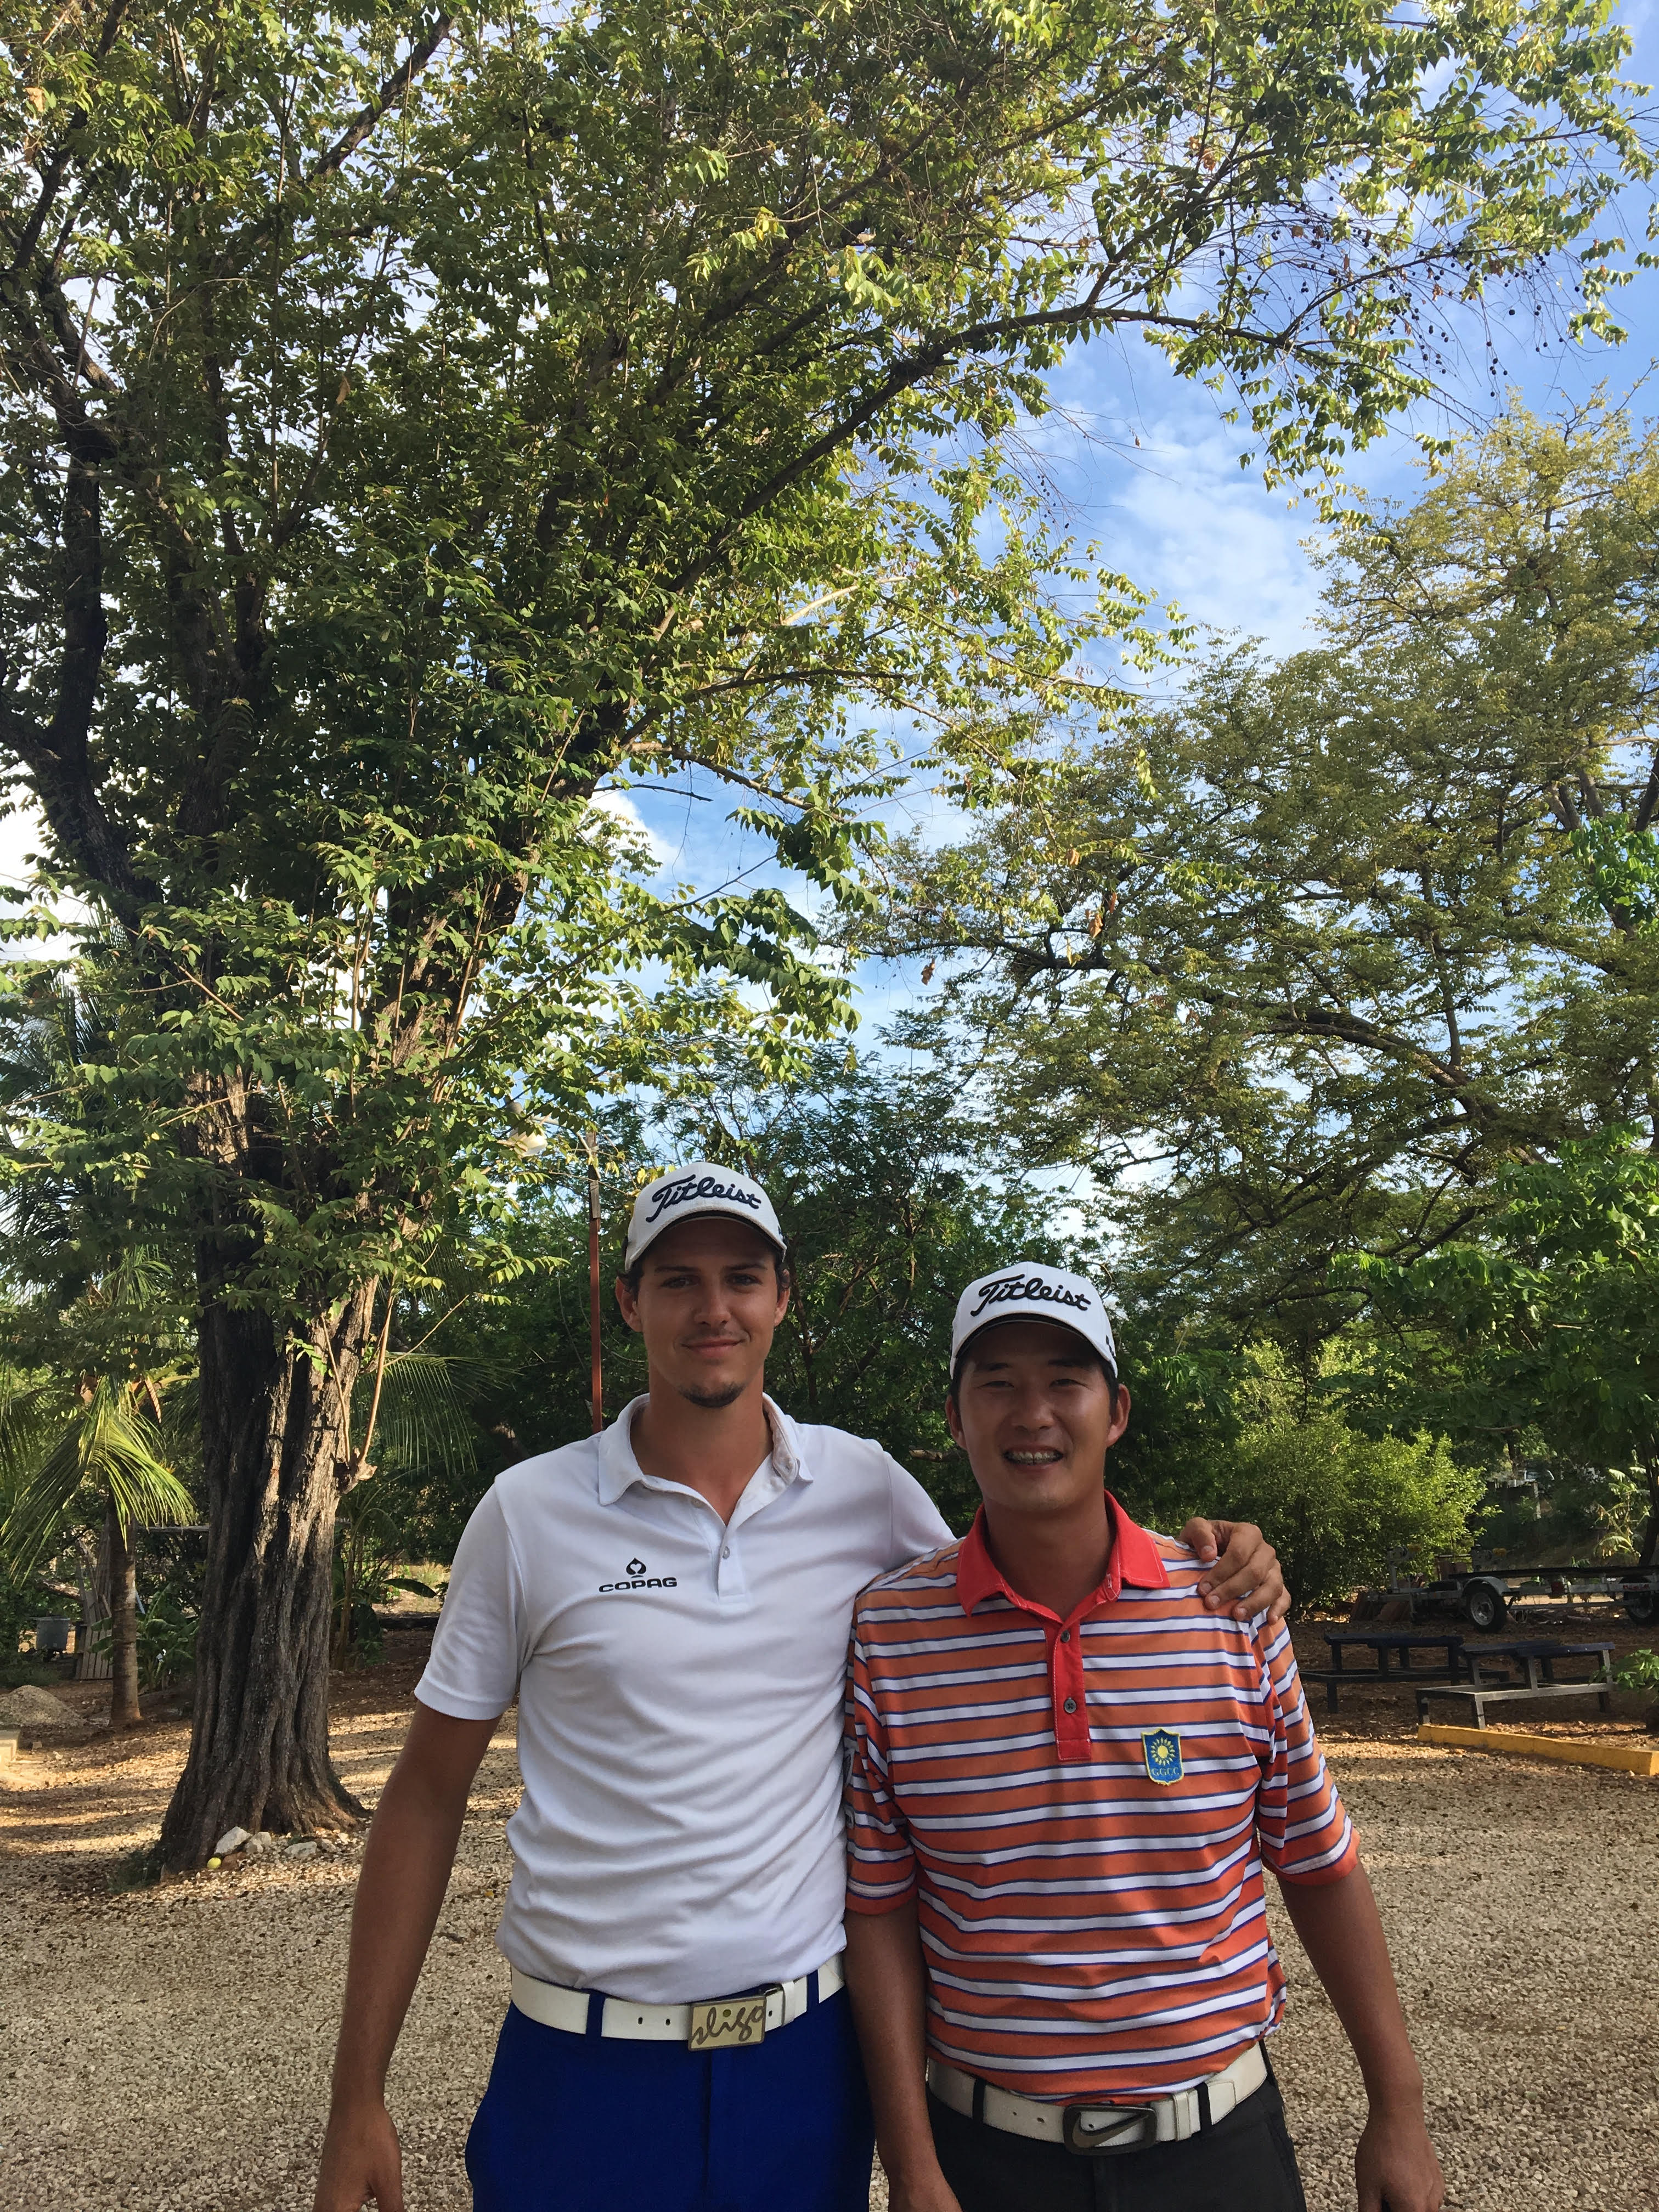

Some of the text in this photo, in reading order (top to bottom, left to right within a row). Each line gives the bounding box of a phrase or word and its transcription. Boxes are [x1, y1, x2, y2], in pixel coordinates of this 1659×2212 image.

[645, 1174, 761, 1222] Titleist
[970, 1274, 1091, 1317] Titleist
[599, 1577, 678, 1593] COPAG
[690, 2005, 764, 2045] sligo
